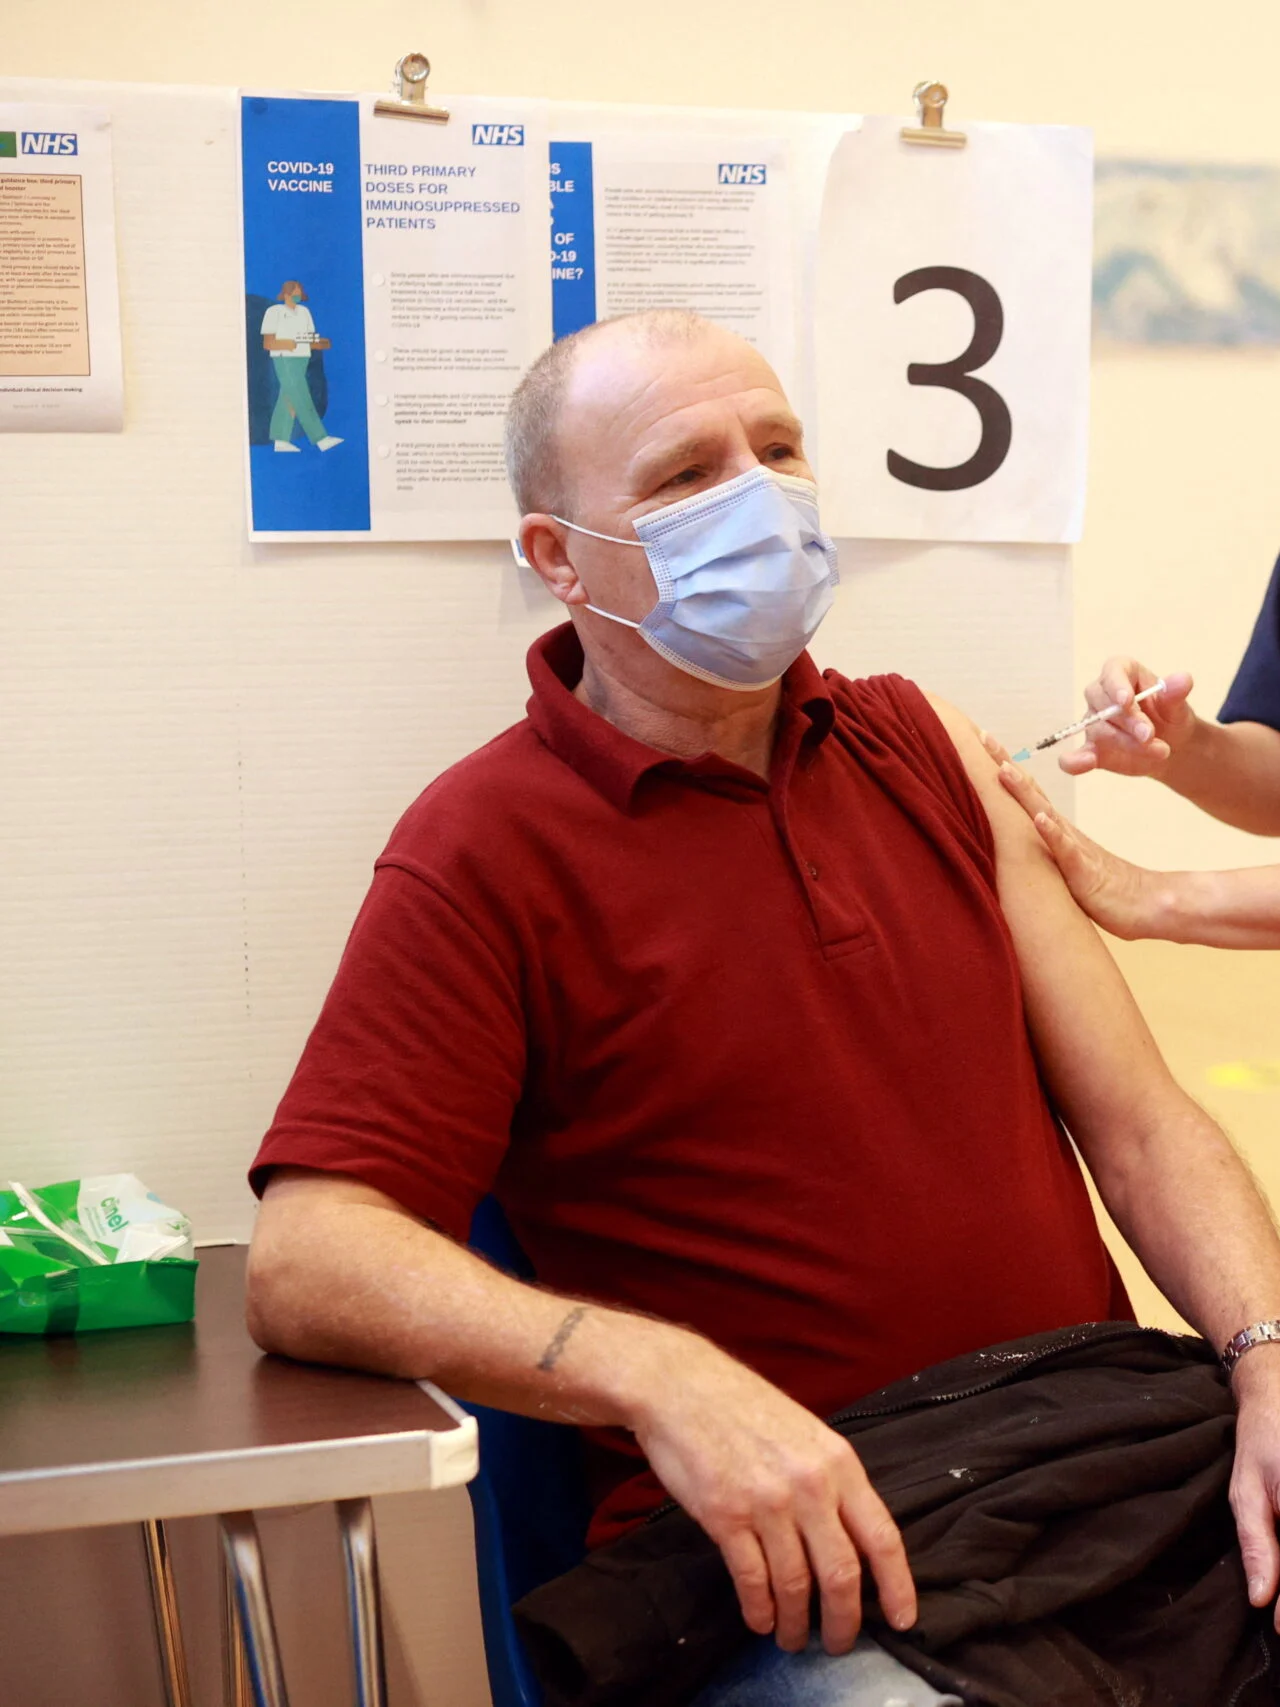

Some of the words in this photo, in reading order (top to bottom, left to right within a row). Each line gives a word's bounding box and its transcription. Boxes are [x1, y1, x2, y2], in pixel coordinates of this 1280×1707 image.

[472, 124, 525, 146] NHS
[22, 132, 78, 155] NHS
[267, 161, 334, 175] COVID-19
[365, 164, 408, 176] THIRD
[412, 165, 476, 178] PRIMARY
[718, 163, 766, 185] NHS
[267, 179, 333, 193] VACCINE
[365, 182, 415, 194] DOSES
[418, 183, 448, 194] FOR
[365, 200, 521, 214] IMMUNOSUPPRESSED
[366, 217, 437, 230] PATIENTS
[554, 232, 576, 246] OF
[886, 265, 1013, 492] 3
